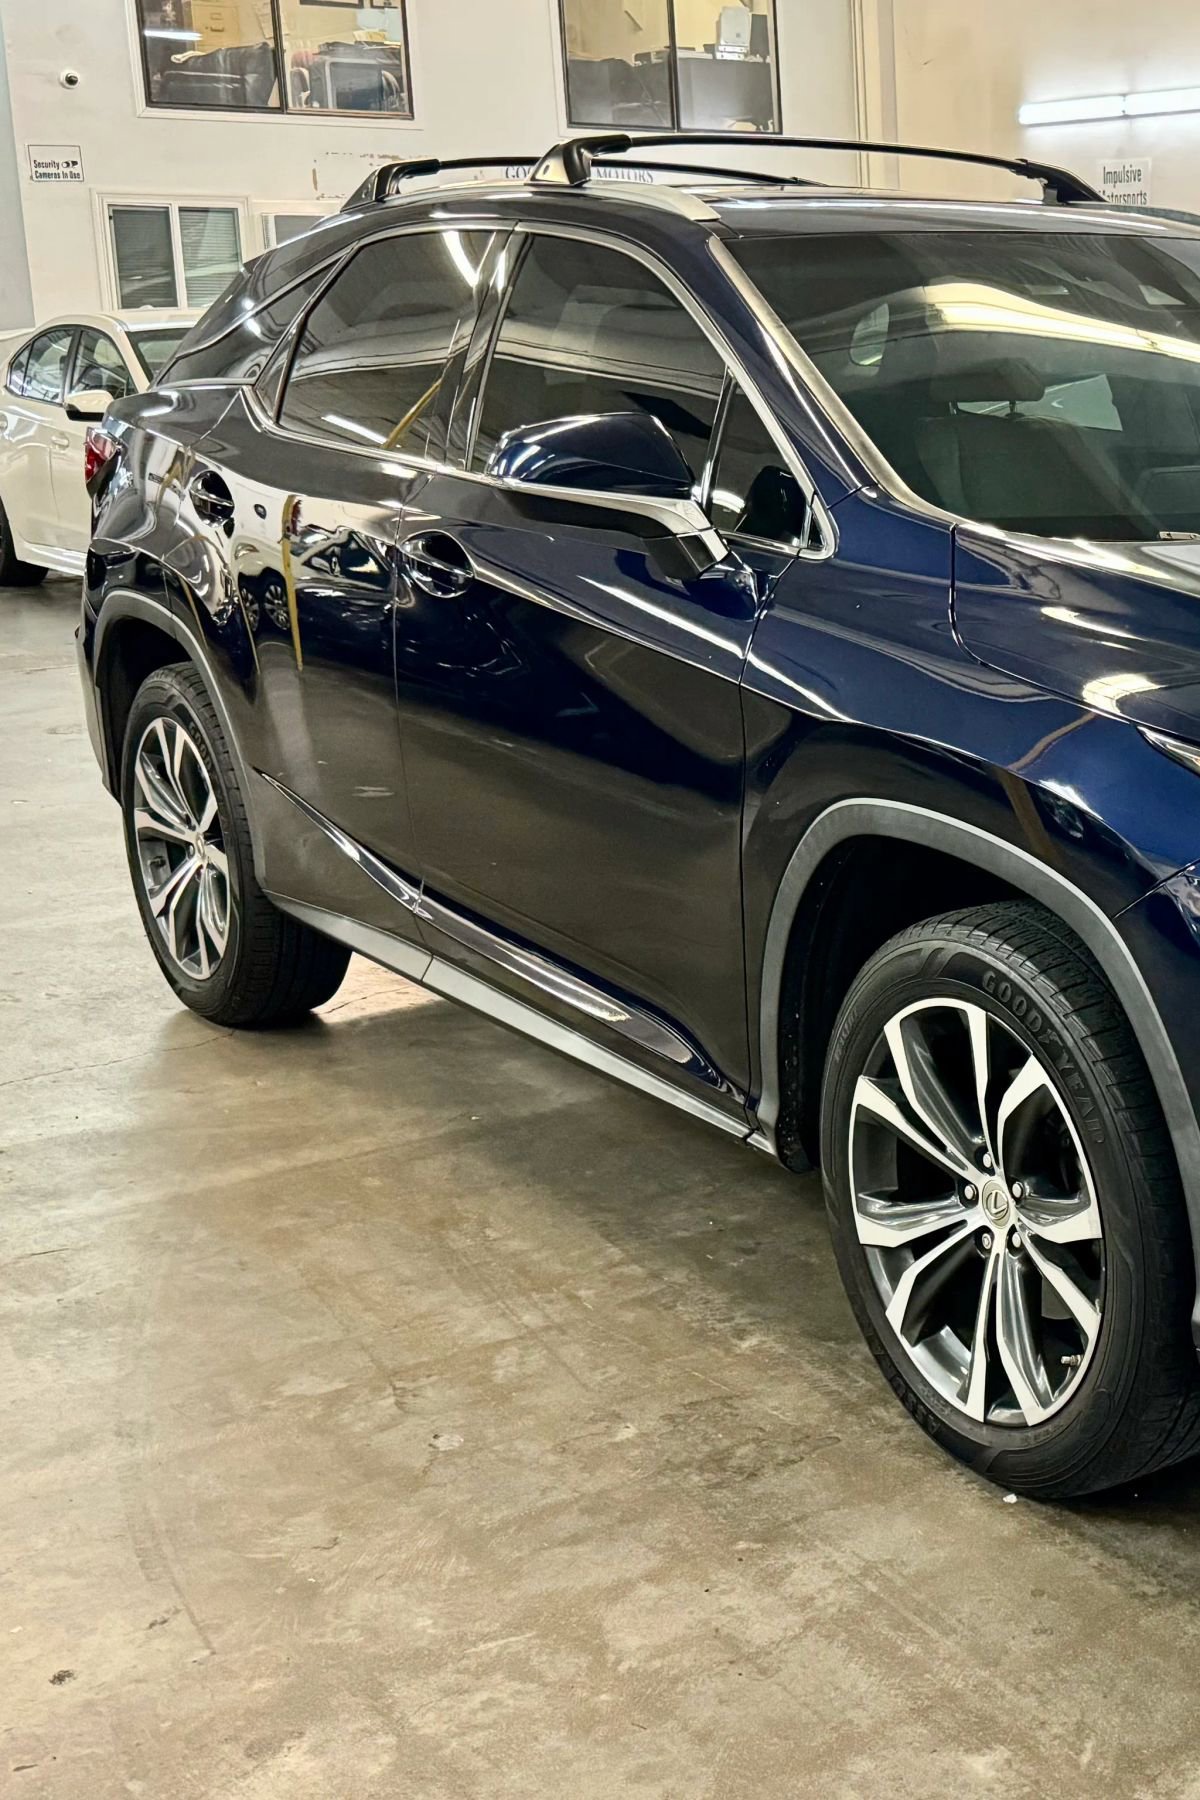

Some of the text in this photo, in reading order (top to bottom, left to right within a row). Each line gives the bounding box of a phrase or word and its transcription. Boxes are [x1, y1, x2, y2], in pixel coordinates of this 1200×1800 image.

[33, 159, 60, 170] Security
[34, 170, 60, 179] Cameras
[69, 170, 81, 179] Use
[1103, 164, 1142, 188] Impulsive
